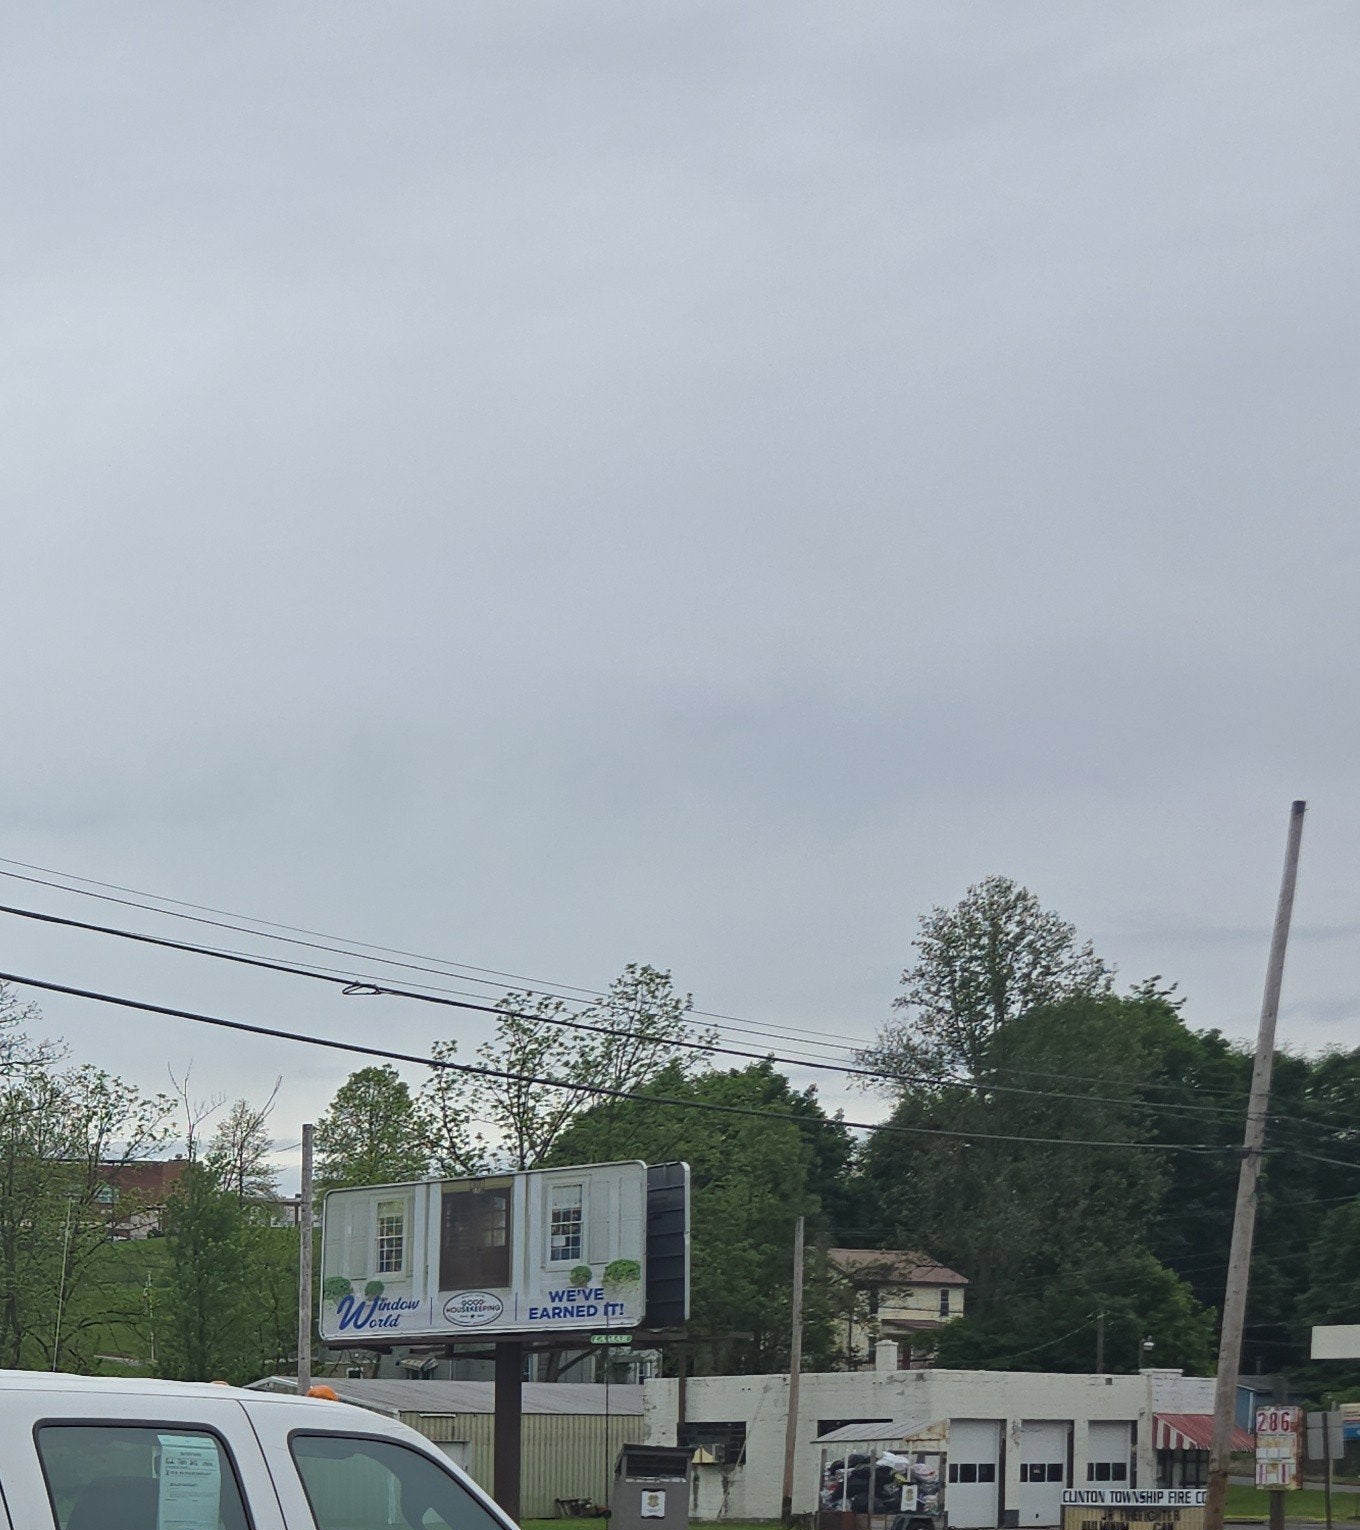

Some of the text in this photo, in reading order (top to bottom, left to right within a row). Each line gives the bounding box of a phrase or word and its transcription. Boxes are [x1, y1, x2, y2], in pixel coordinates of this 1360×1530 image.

[548, 1288, 604, 1303] WE'VE
[529, 1303, 624, 1320] EARNED IT!
[1258, 1412, 1290, 1431] 286
[1063, 1490, 1105, 1503] CLINTON
[1110, 1490, 1164, 1504] TOWNSHIP
[1168, 1491, 1191, 1504] FIRE
